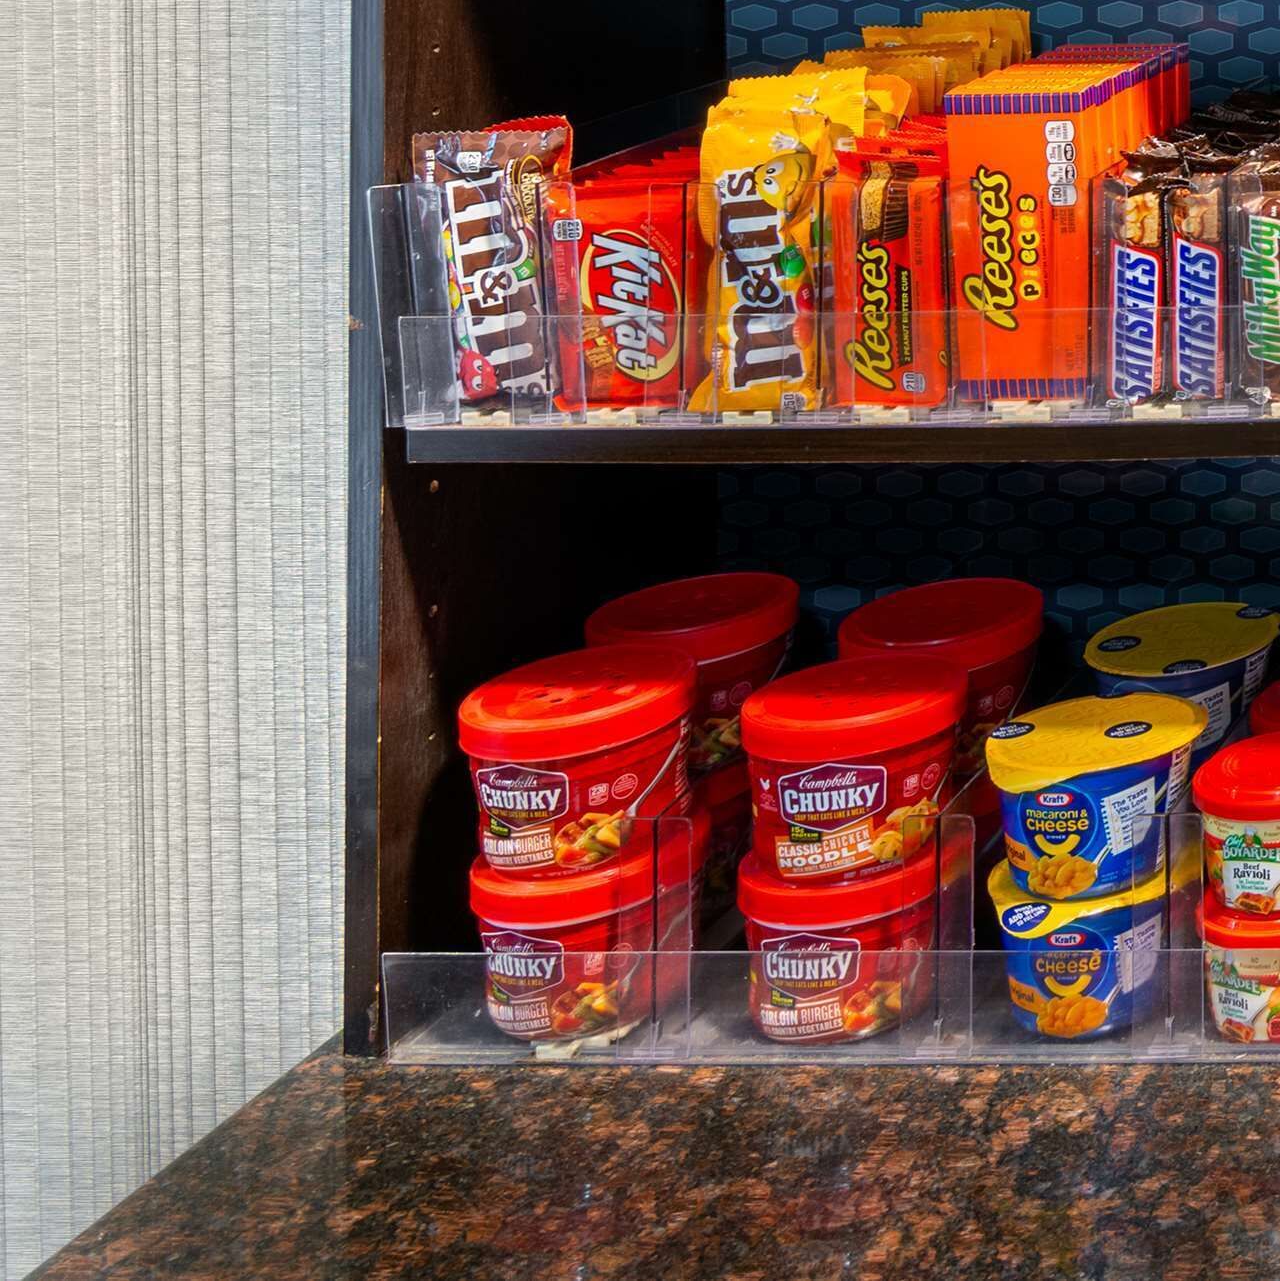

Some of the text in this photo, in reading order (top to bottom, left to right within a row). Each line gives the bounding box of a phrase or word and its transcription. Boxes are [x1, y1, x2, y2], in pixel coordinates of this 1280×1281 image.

[962, 167, 1019, 331] Reese's
[1018, 194, 1041, 300] pieces
[844, 244, 896, 391] Reese's
[799, 771, 858, 791] Campbell's
[784, 783, 880, 814] CHUNKY
[1042, 795, 1064, 804] Kraft
[1026, 809, 1088, 818] macaroni &
[778, 828, 870, 857] CLASSIC CHICKEN
[780, 841, 872, 868] NOODLE
[1233, 868, 1271, 880] Ravioli
